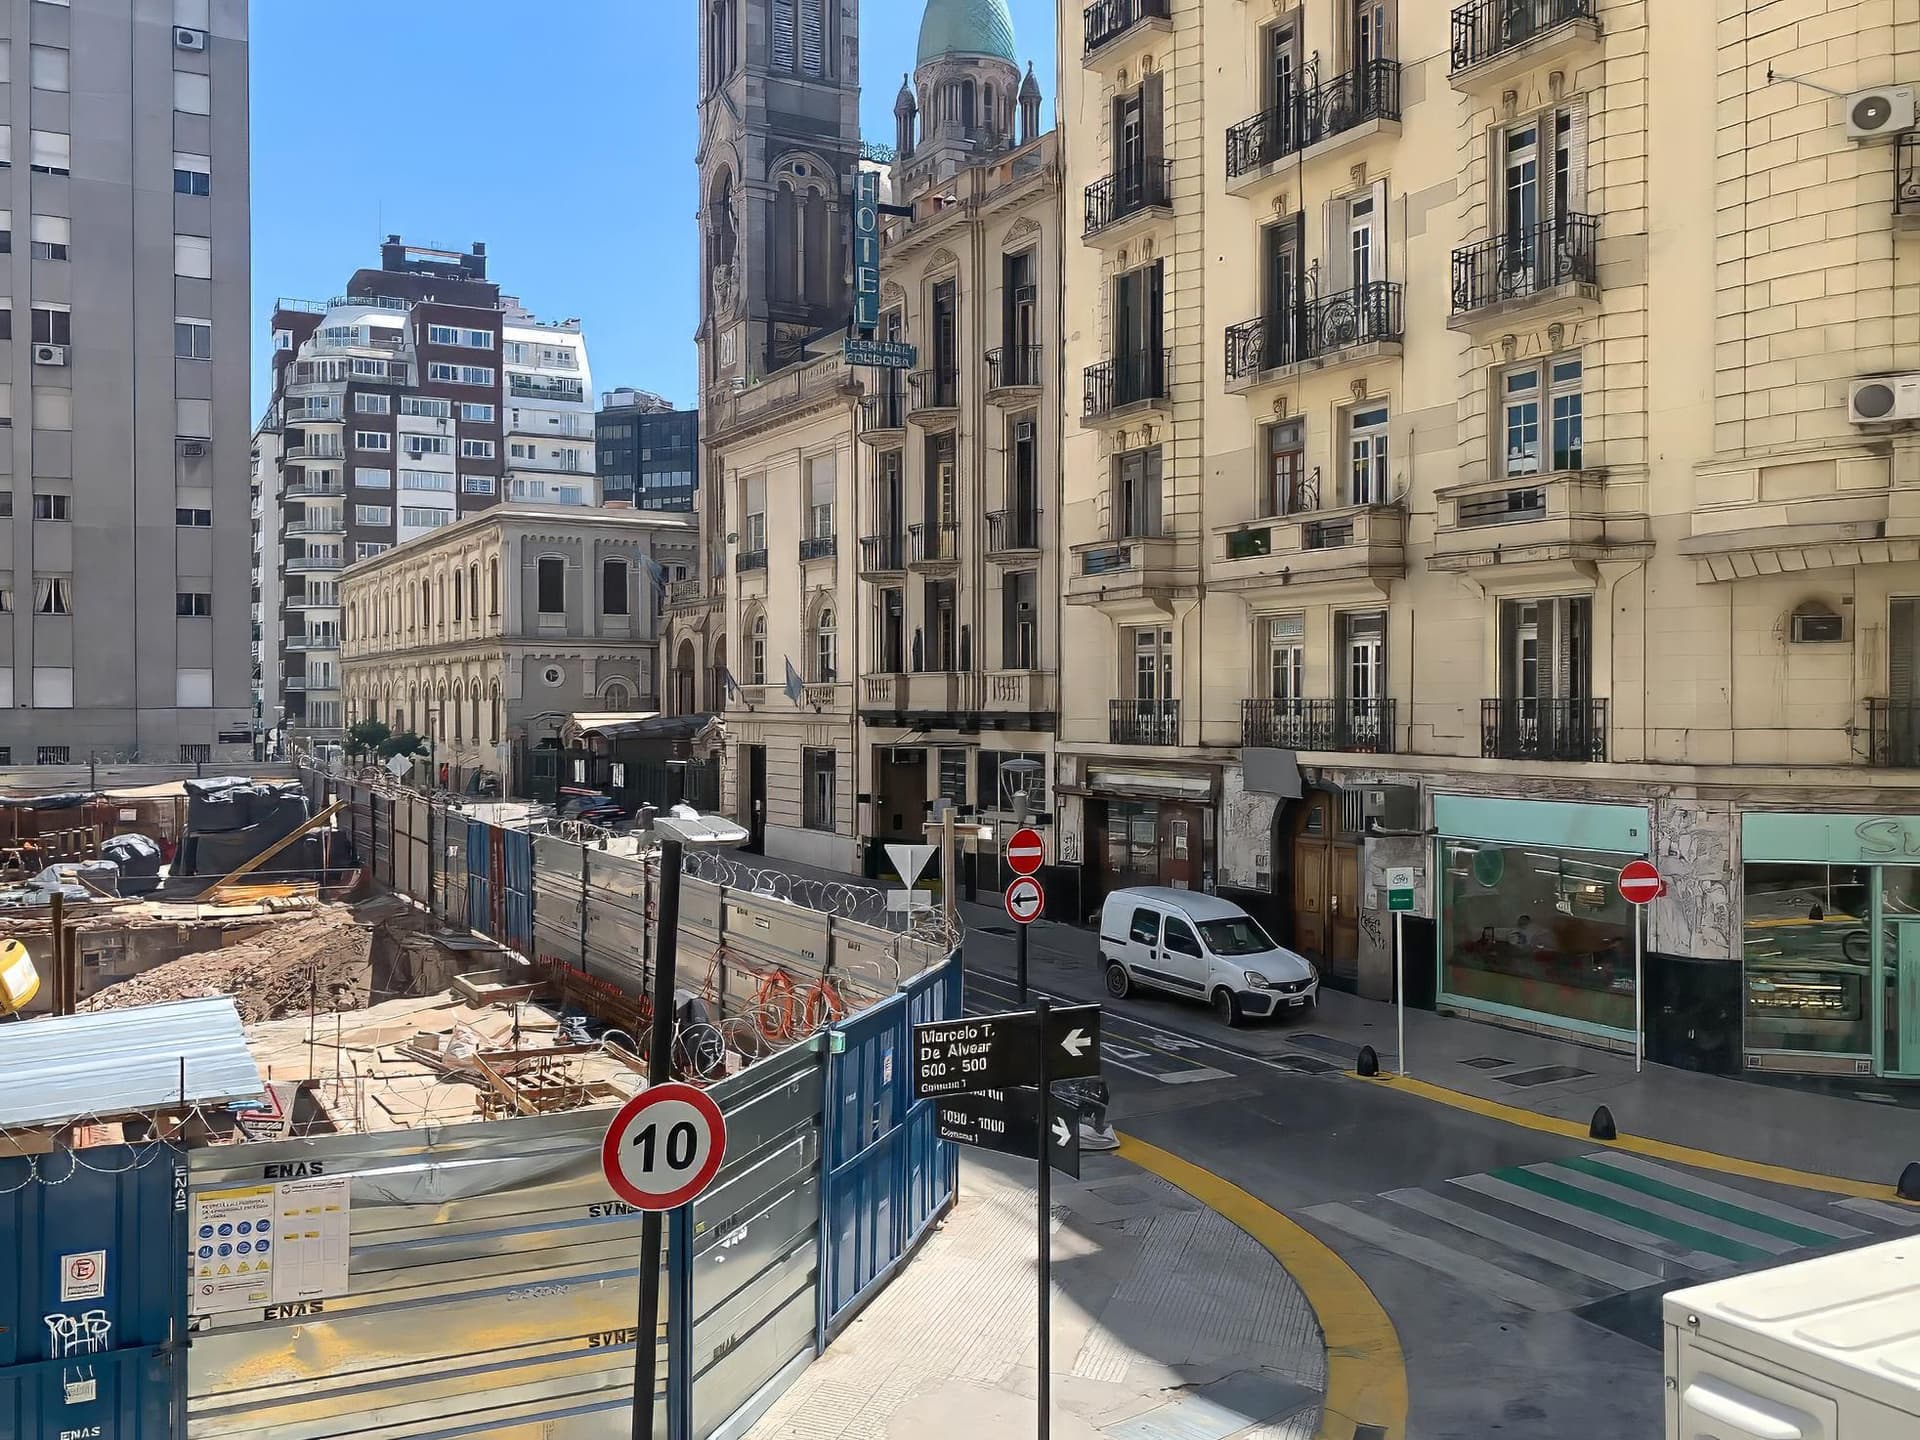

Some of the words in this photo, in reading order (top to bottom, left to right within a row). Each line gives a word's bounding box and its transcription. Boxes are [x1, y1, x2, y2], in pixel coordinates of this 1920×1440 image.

[857, 174, 877, 324] HOTEL
[921, 1025, 978, 1045] Marcelo
[981, 1023, 996, 1038] T.
[920, 1047, 941, 1061] De
[947, 1042, 992, 1058] Alvear
[921, 1062, 946, 1077] 600
[962, 1057, 987, 1073] 500
[978, 1116, 1005, 1134] 1000
[632, 1121, 698, 1173] 10
[263, 1161, 324, 1179] ENAS
[174, 1165, 187, 1211] ENAS
[263, 1300, 324, 1320] ENAS
[60, 1426, 101, 1440] ENAS
